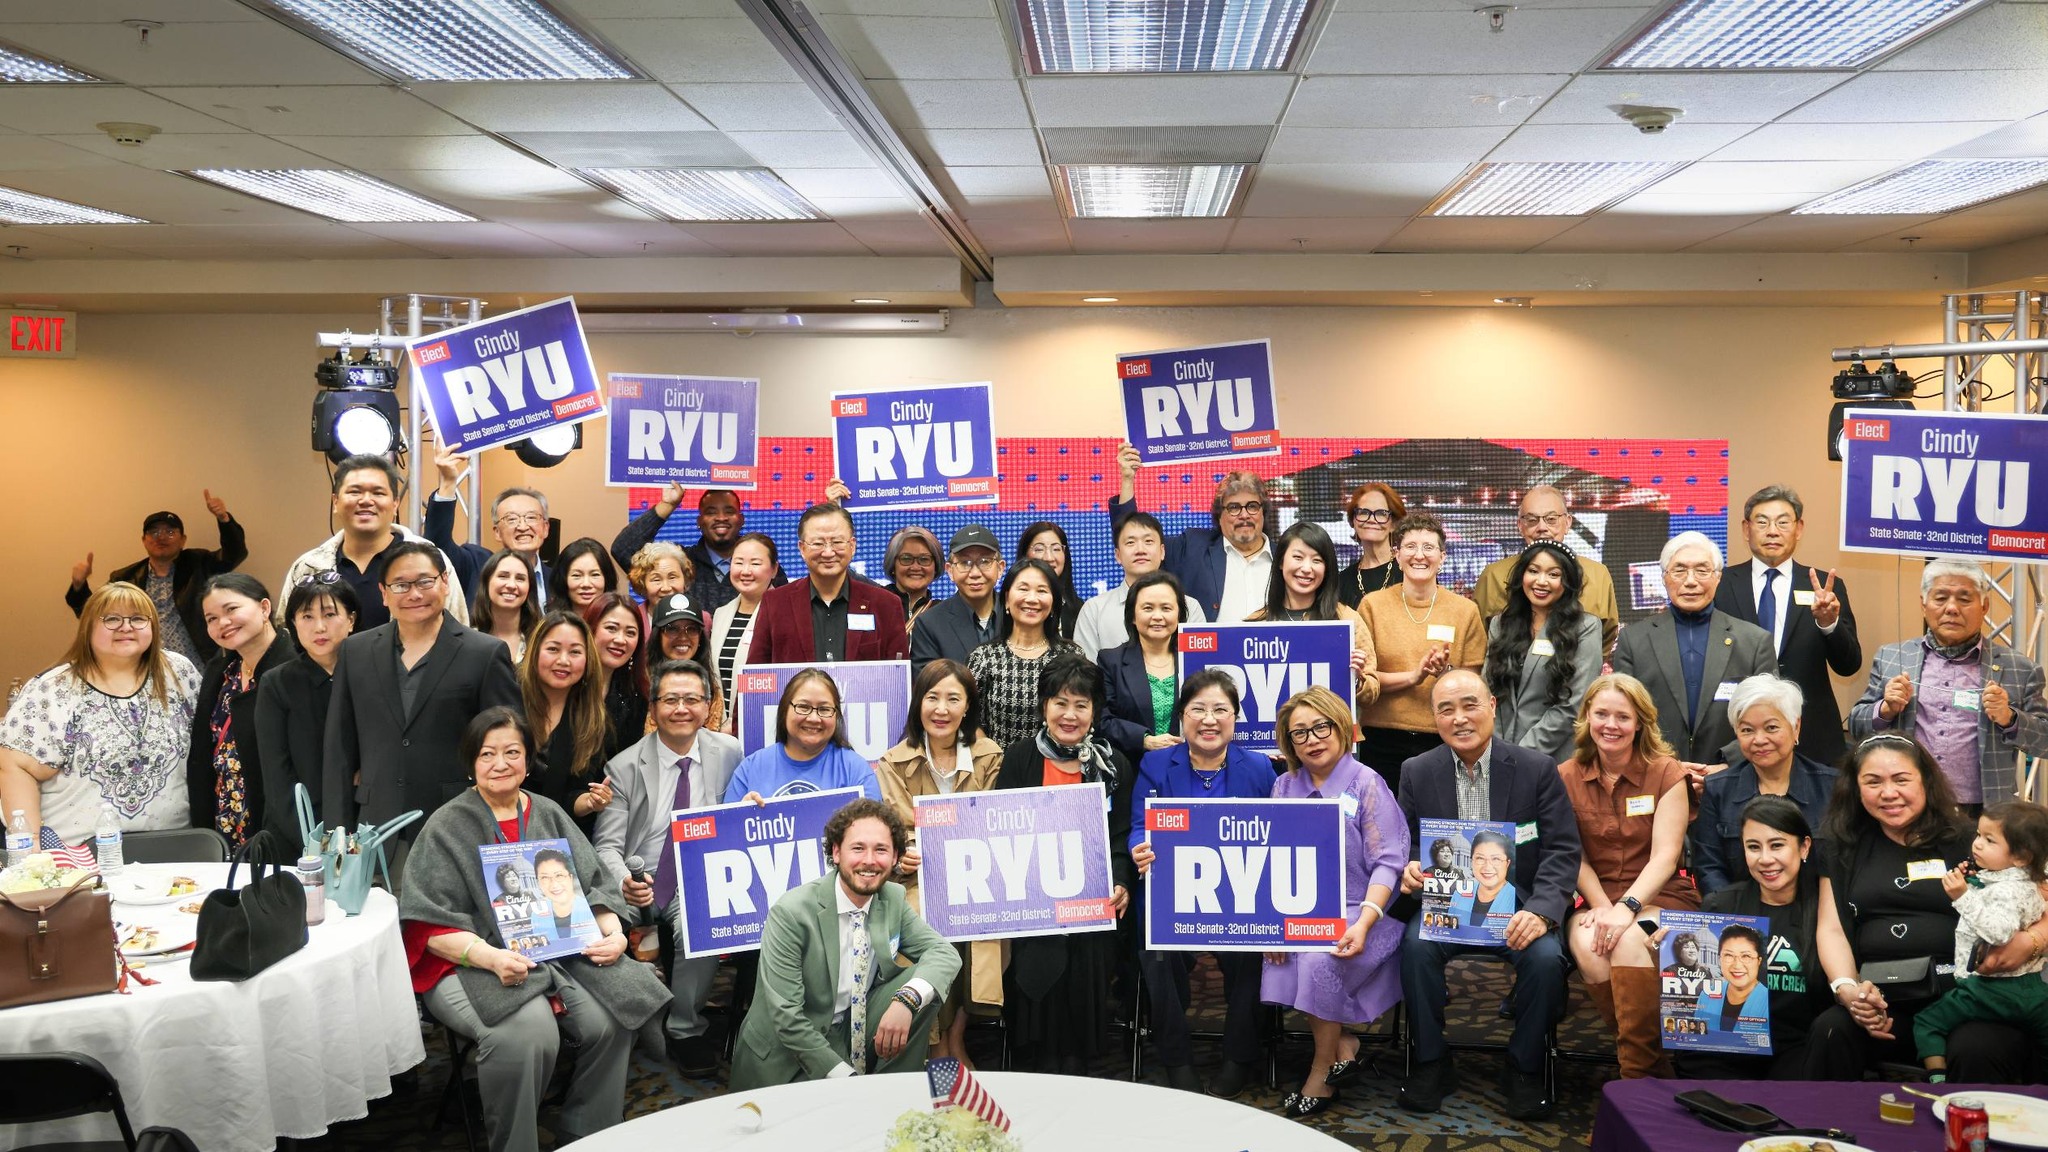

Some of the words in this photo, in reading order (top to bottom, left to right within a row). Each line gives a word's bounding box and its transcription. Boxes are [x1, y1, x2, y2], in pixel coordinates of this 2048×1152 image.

[11, 315, 65, 352] EXIT
[474, 329, 520, 358] Cindy
[421, 345, 446, 364] Elect
[1126, 363, 1147, 376] Elect
[1174, 358, 1214, 381] Cindy
[443, 340, 574, 426] RYU
[617, 384, 638, 396] Elect
[664, 388, 704, 411] Cindy
[840, 402, 863, 415] Elect
[1142, 378, 1255, 439] RYU
[463, 428, 482, 443] State
[482, 423, 505, 438] Senate
[508, 416, 525, 430] 32nd
[526, 409, 551, 425] District
[556, 396, 597, 416] Democrat
[891, 399, 933, 423] Cindy
[628, 409, 738, 464] RYU
[1855, 422, 1885, 438] Elect
[856, 421, 973, 482] RYU
[1148, 444, 1164, 454] State
[1165, 443, 1185, 452] Senate
[1189, 440, 1204, 450] 32nd
[1205, 438, 1228, 449] District
[1234, 434, 1271, 447] Democrat
[1921, 428, 1979, 458] Cindy
[628, 466, 644, 475] State
[645, 467, 665, 476] Senate
[668, 468, 684, 477] 32nd
[685, 468, 708, 478] District
[714, 468, 750, 479] Democrat
[859, 488, 875, 498] State
[877, 487, 899, 497] Senate
[902, 486, 919, 496] 32nd
[920, 484, 944, 495] District
[950, 481, 989, 493] Democrat
[1871, 454, 2030, 528] RYU
[1870, 527, 1891, 539] State
[1893, 528, 1922, 541] Senate
[1927, 530, 1948, 543] 32nd
[1950, 531, 1983, 545] District
[1992, 534, 2045, 549] Democrat
[1188, 636, 1213, 649] Elect
[1243, 637, 1289, 662] Cindy
[748, 677, 772, 690] Elect
[1231, 732, 1249, 741] nate
[1252, 731, 1270, 741] 32nd
[744, 812, 795, 841] Cindy
[925, 809, 952, 825] Elect
[985, 806, 1036, 832] Cindy
[1157, 813, 1184, 828] Elect
[684, 822, 711, 838] Elect
[1219, 816, 1271, 845] Cindy
[944, 830, 1086, 906] RYU
[1435, 869, 1459, 880] Cindy
[1174, 846, 1317, 915] RYU
[1424, 878, 1474, 894] RYU
[506, 894, 532, 904] Cindy
[495, 901, 549, 922] RYU
[949, 914, 969, 926] State
[971, 912, 997, 924] Senate
[1001, 910, 1020, 921] 32nd
[1022, 908, 1051, 920] District
[1058, 904, 1105, 918] Democrat
[712, 926, 732, 938] State
[733, 922, 760, 936] Senate
[1175, 923, 1194, 934] State
[1196, 923, 1224, 934] Senate
[1228, 923, 1248, 934] 32nd
[1250, 923, 1279, 935] District
[1288, 922, 1335, 936] Democrat
[1678, 966, 1706, 979] Cindy
[1662, 977, 1722, 995] RYU
